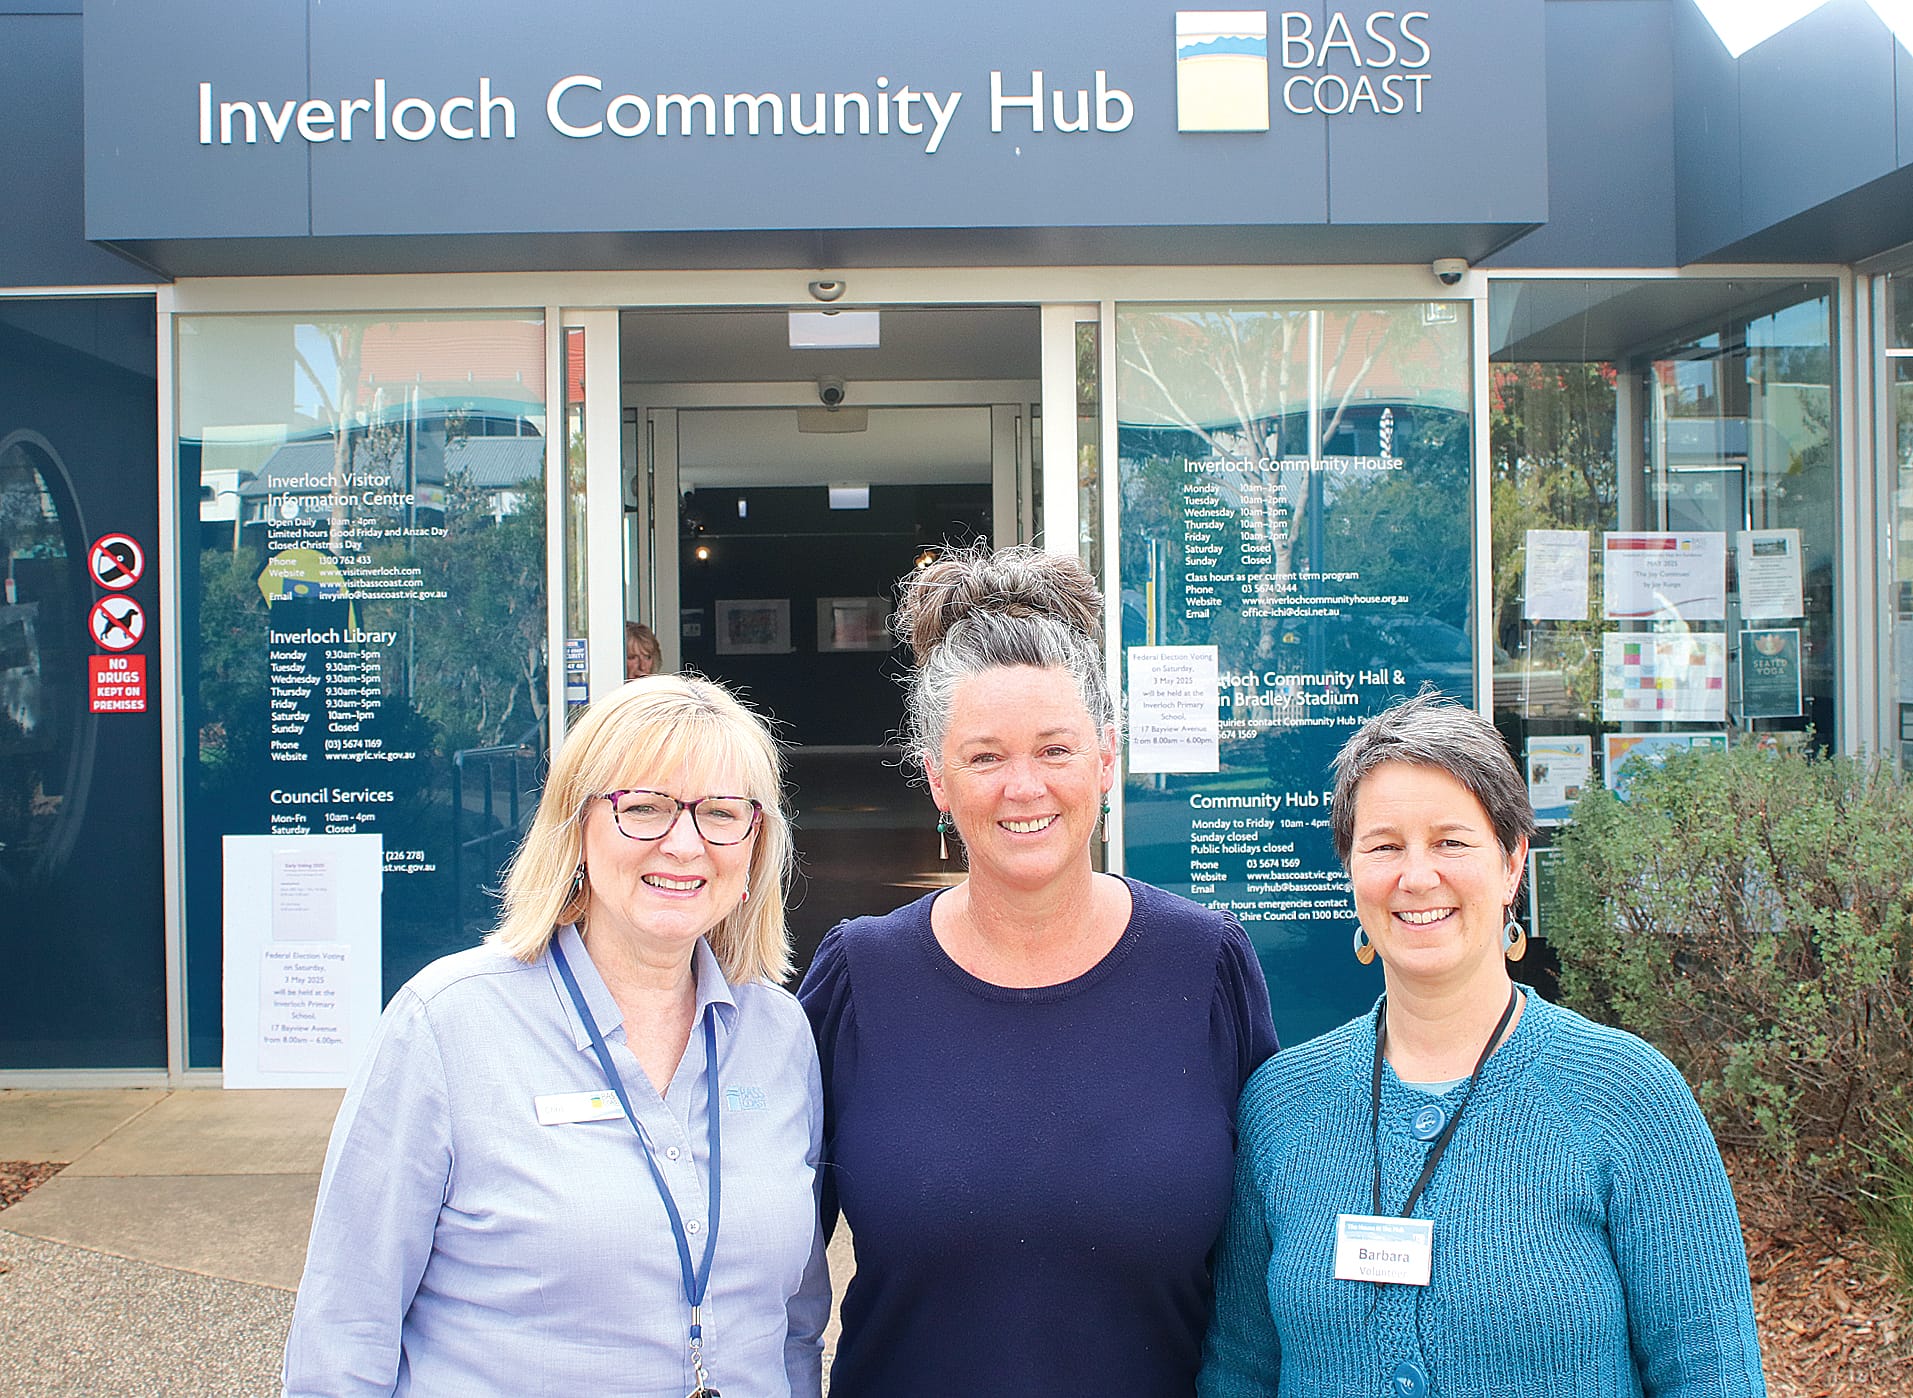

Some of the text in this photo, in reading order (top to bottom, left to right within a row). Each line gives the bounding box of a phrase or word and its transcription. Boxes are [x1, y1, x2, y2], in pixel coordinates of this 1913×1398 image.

[1281, 12, 1431, 68] BASS
[1282, 74, 1431, 114] COAST
[200, 70, 1135, 153] Inverloch Community Hub
[1184, 457, 1403, 474] Inverloch Community House
[267, 473, 391, 488] Inverloch Visitor
[1184, 484, 1220, 494] Monday
[267, 492, 414, 507] Information Centre
[1184, 496, 1219, 506] Tuesday
[1184, 508, 1235, 518] Wednesday
[267, 517, 376, 528] Open Daily 10am 4pm
[1184, 520, 1224, 531] Thursday
[267, 527, 448, 539] Limited hours Good Friday and Anzac Day
[1185, 532, 1210, 543] Friday
[268, 540, 362, 551] Closed Christmas Day
[1185, 543, 1271, 555] Saturday Closed
[269, 556, 371, 566] Phone 1300 762 433
[1185, 555, 1271, 567] Sunday Closed
[269, 567, 421, 577] Website www.visitinverloch.com
[1185, 572, 1359, 583] Class hours current term program
[319, 578, 423, 588] www.visitbasscoast.com
[1186, 583, 1297, 594] Phone 03 5674 2444
[269, 592, 293, 601] Email
[1186, 597, 1222, 606] Website
[1186, 609, 1209, 618] Email
[270, 628, 397, 646] Inverloch Library
[270, 650, 307, 661] Monday
[1133, 653, 1213, 662] Federal Election Voting
[109, 658, 127, 669] NO
[270, 663, 305, 673] Tuesday
[1753, 658, 1788, 668] SEATED
[1757, 667, 1784, 675] YOGA
[97, 672, 139, 683] DRUGS
[270, 674, 321, 685] Wednesday
[1160, 677, 1174, 686] May
[1264, 669, 1406, 689] Community Hall &
[97, 687, 140, 696] KEPT ON
[270, 687, 311, 698] Thursday
[270, 699, 298, 710] Friday
[1234, 689, 1359, 709] Bradley Stadium
[93, 700, 144, 710] PREMISES
[1143, 701, 1204, 710] Inverloch Primary
[271, 711, 310, 722] Saturday
[1248, 718, 1282, 726] contact
[1284, 717, 1335, 727] Community
[1337, 716, 1356, 725] Hub
[271, 722, 360, 735] Sunday Closed
[1238, 730, 1257, 738] 1569
[270, 739, 382, 750] Phone (03) 5674 1169
[270, 752, 308, 761] Website
[270, 788, 394, 804] Council Services
[1190, 792, 1281, 811] Community
[1286, 791, 1318, 807] Hub
[271, 813, 376, 823] Mon-Fri 10am 4pm
[271, 824, 356, 835] Saturday Closed
[1192, 819, 1230, 831] Monday
[1233, 820, 1244, 828] to
[1246, 818, 1274, 830] Friday
[1280, 819, 1304, 828] 10am
[1190, 832, 1258, 844] Sunday closed
[1191, 843, 1294, 855] Public holidays closed
[386, 851, 425, 861] (226 278)
[1190, 859, 1300, 869] Phone 03 5674 1569
[1190, 873, 1227, 881] Website
[1191, 884, 1215, 894] Email
[1208, 900, 1230, 910] after
[1232, 900, 1256, 909] hours
[1258, 899, 1312, 911] emergencies
[1314, 899, 1348, 908] contact
[1240, 910, 1331, 921] Shire Council on 1300
[1359, 1248, 1410, 1262] Barbara
